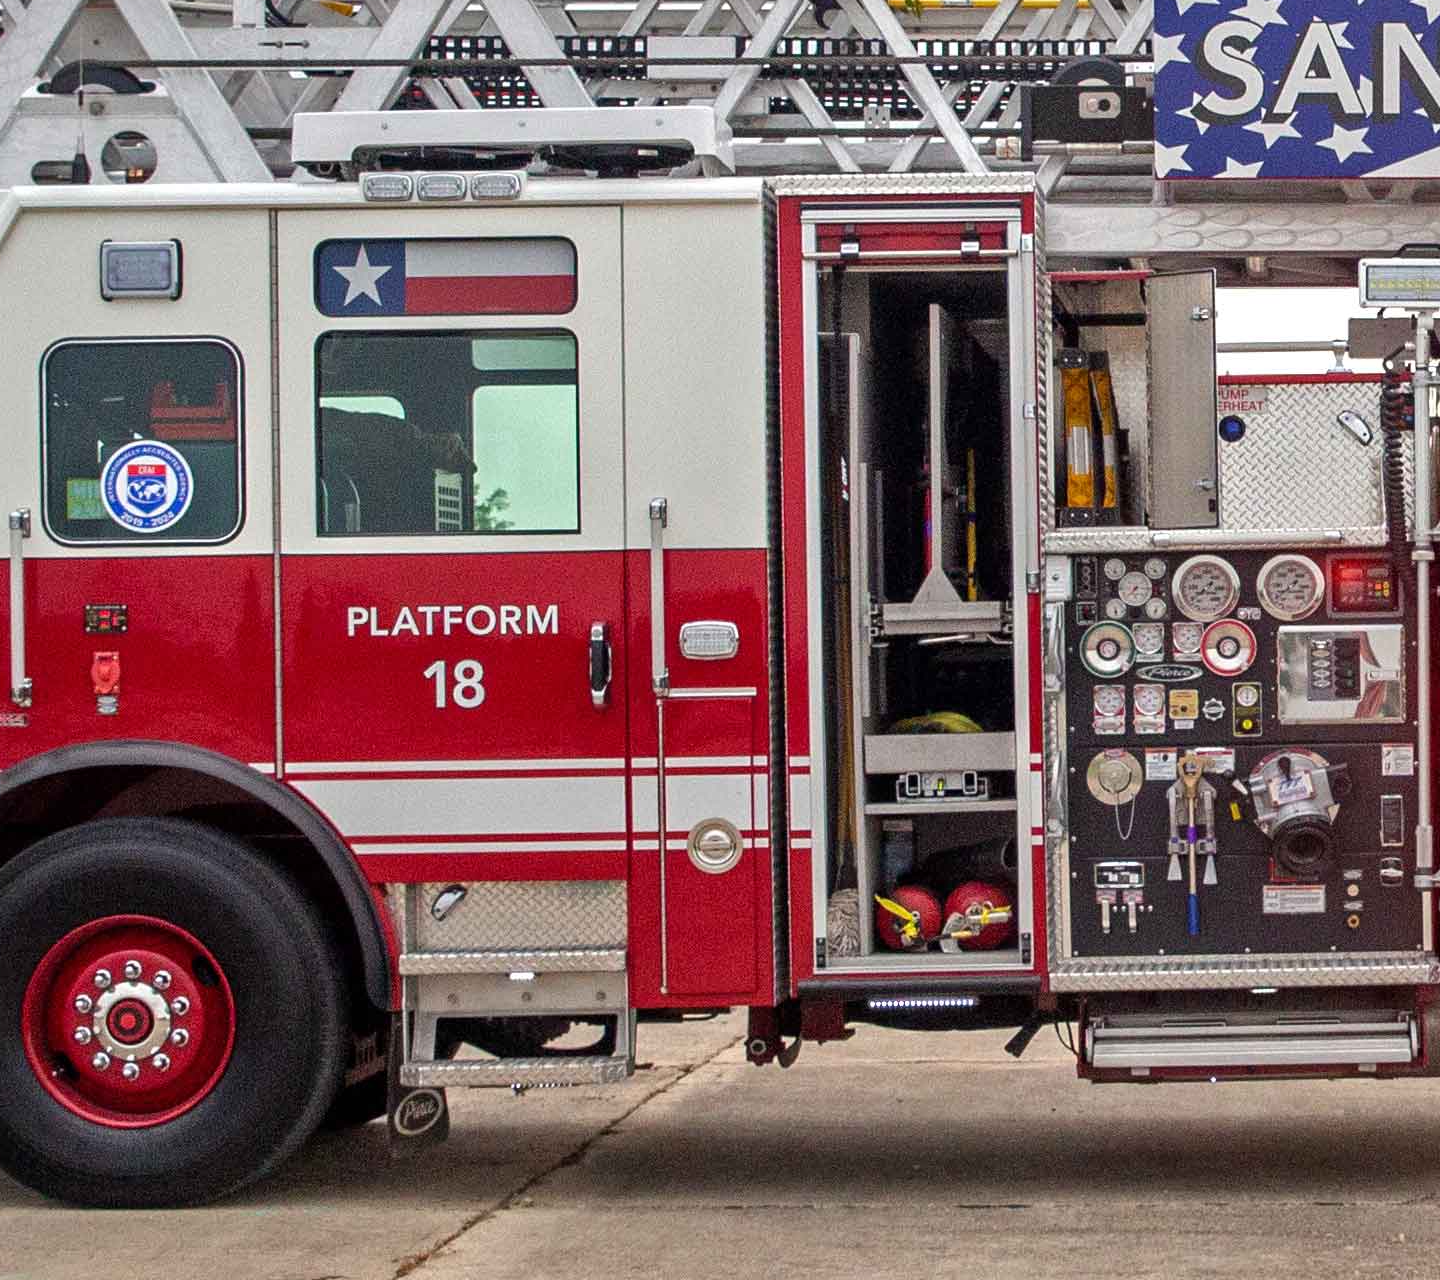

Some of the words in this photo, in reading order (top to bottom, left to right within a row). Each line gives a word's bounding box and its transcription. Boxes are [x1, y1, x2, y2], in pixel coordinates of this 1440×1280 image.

[1218, 388, 1249, 401] UMP
[347, 604, 559, 637] PLATFORM
[423, 659, 486, 709] 18
